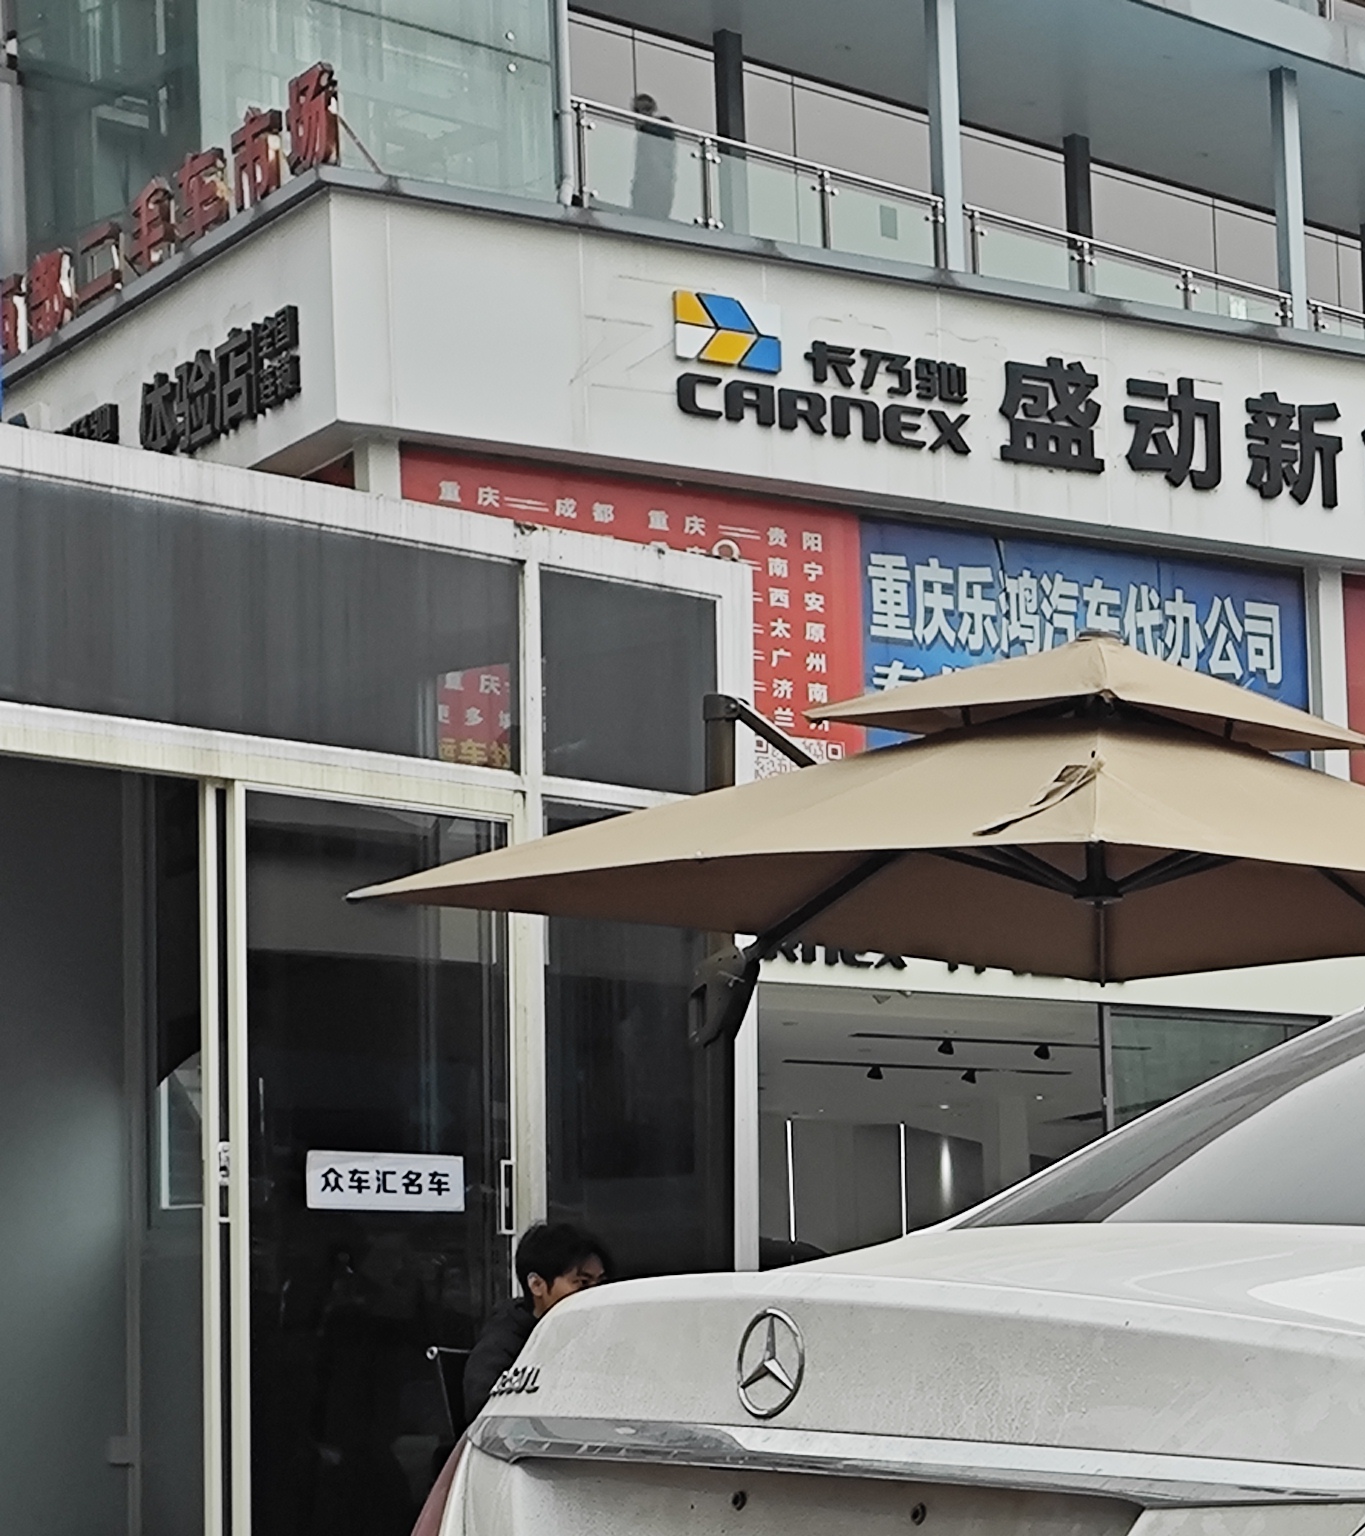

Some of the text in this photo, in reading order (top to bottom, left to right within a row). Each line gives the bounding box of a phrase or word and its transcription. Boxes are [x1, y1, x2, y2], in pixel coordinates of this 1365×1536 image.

[804, 340, 969, 405] 卡乃驰
[676, 372, 972, 456] CARNEX
[438, 480, 824, 552] 重庆 成都 重庆 贵阳
[768, 557, 824, 582] 南宁
[768, 588, 825, 613] 西安
[770, 618, 826, 643] 太原
[771, 648, 827, 674] 广州
[772, 678, 829, 704] 济南
[321, 1167, 450, 1197] 众车汇名车
